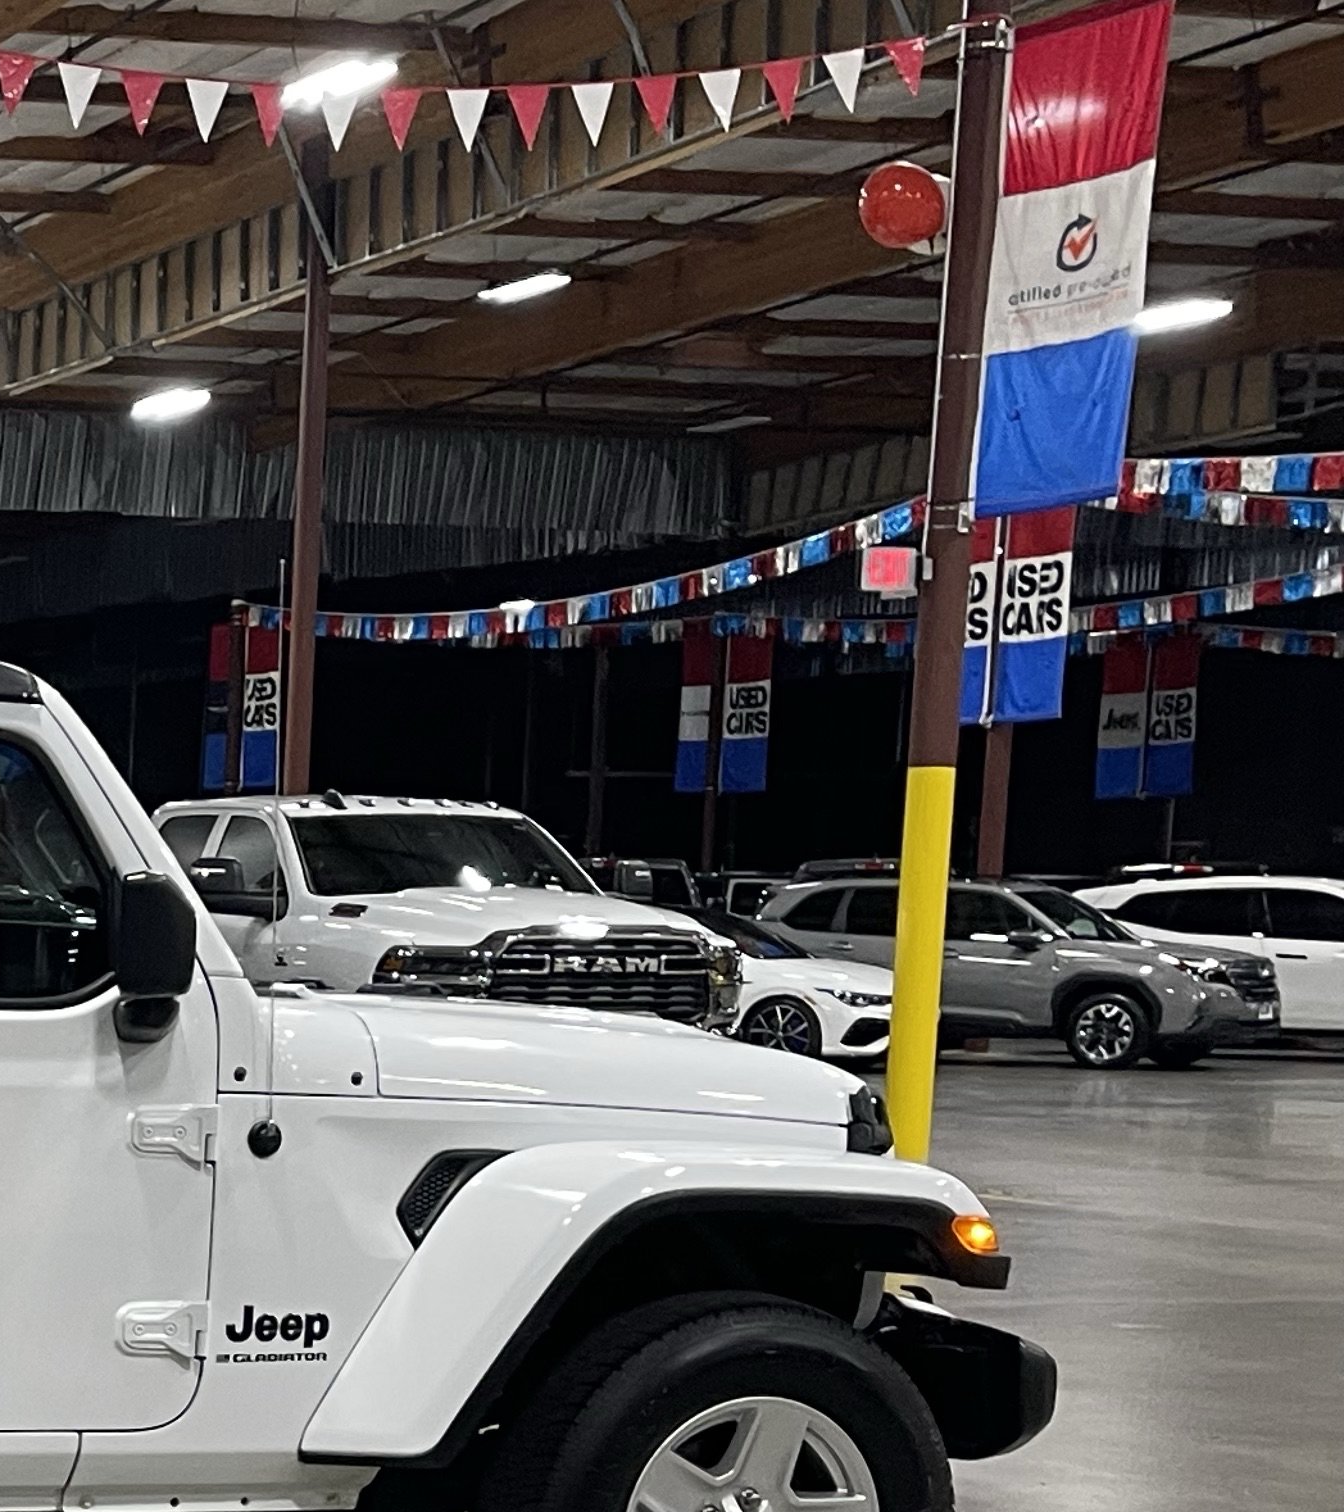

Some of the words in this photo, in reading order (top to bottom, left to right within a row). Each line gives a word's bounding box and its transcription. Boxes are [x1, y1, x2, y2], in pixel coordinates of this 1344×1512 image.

[553, 956, 658, 973] RAM
[225, 1304, 330, 1349] Jeep
[232, 1352, 328, 1363] GLADIATOR
